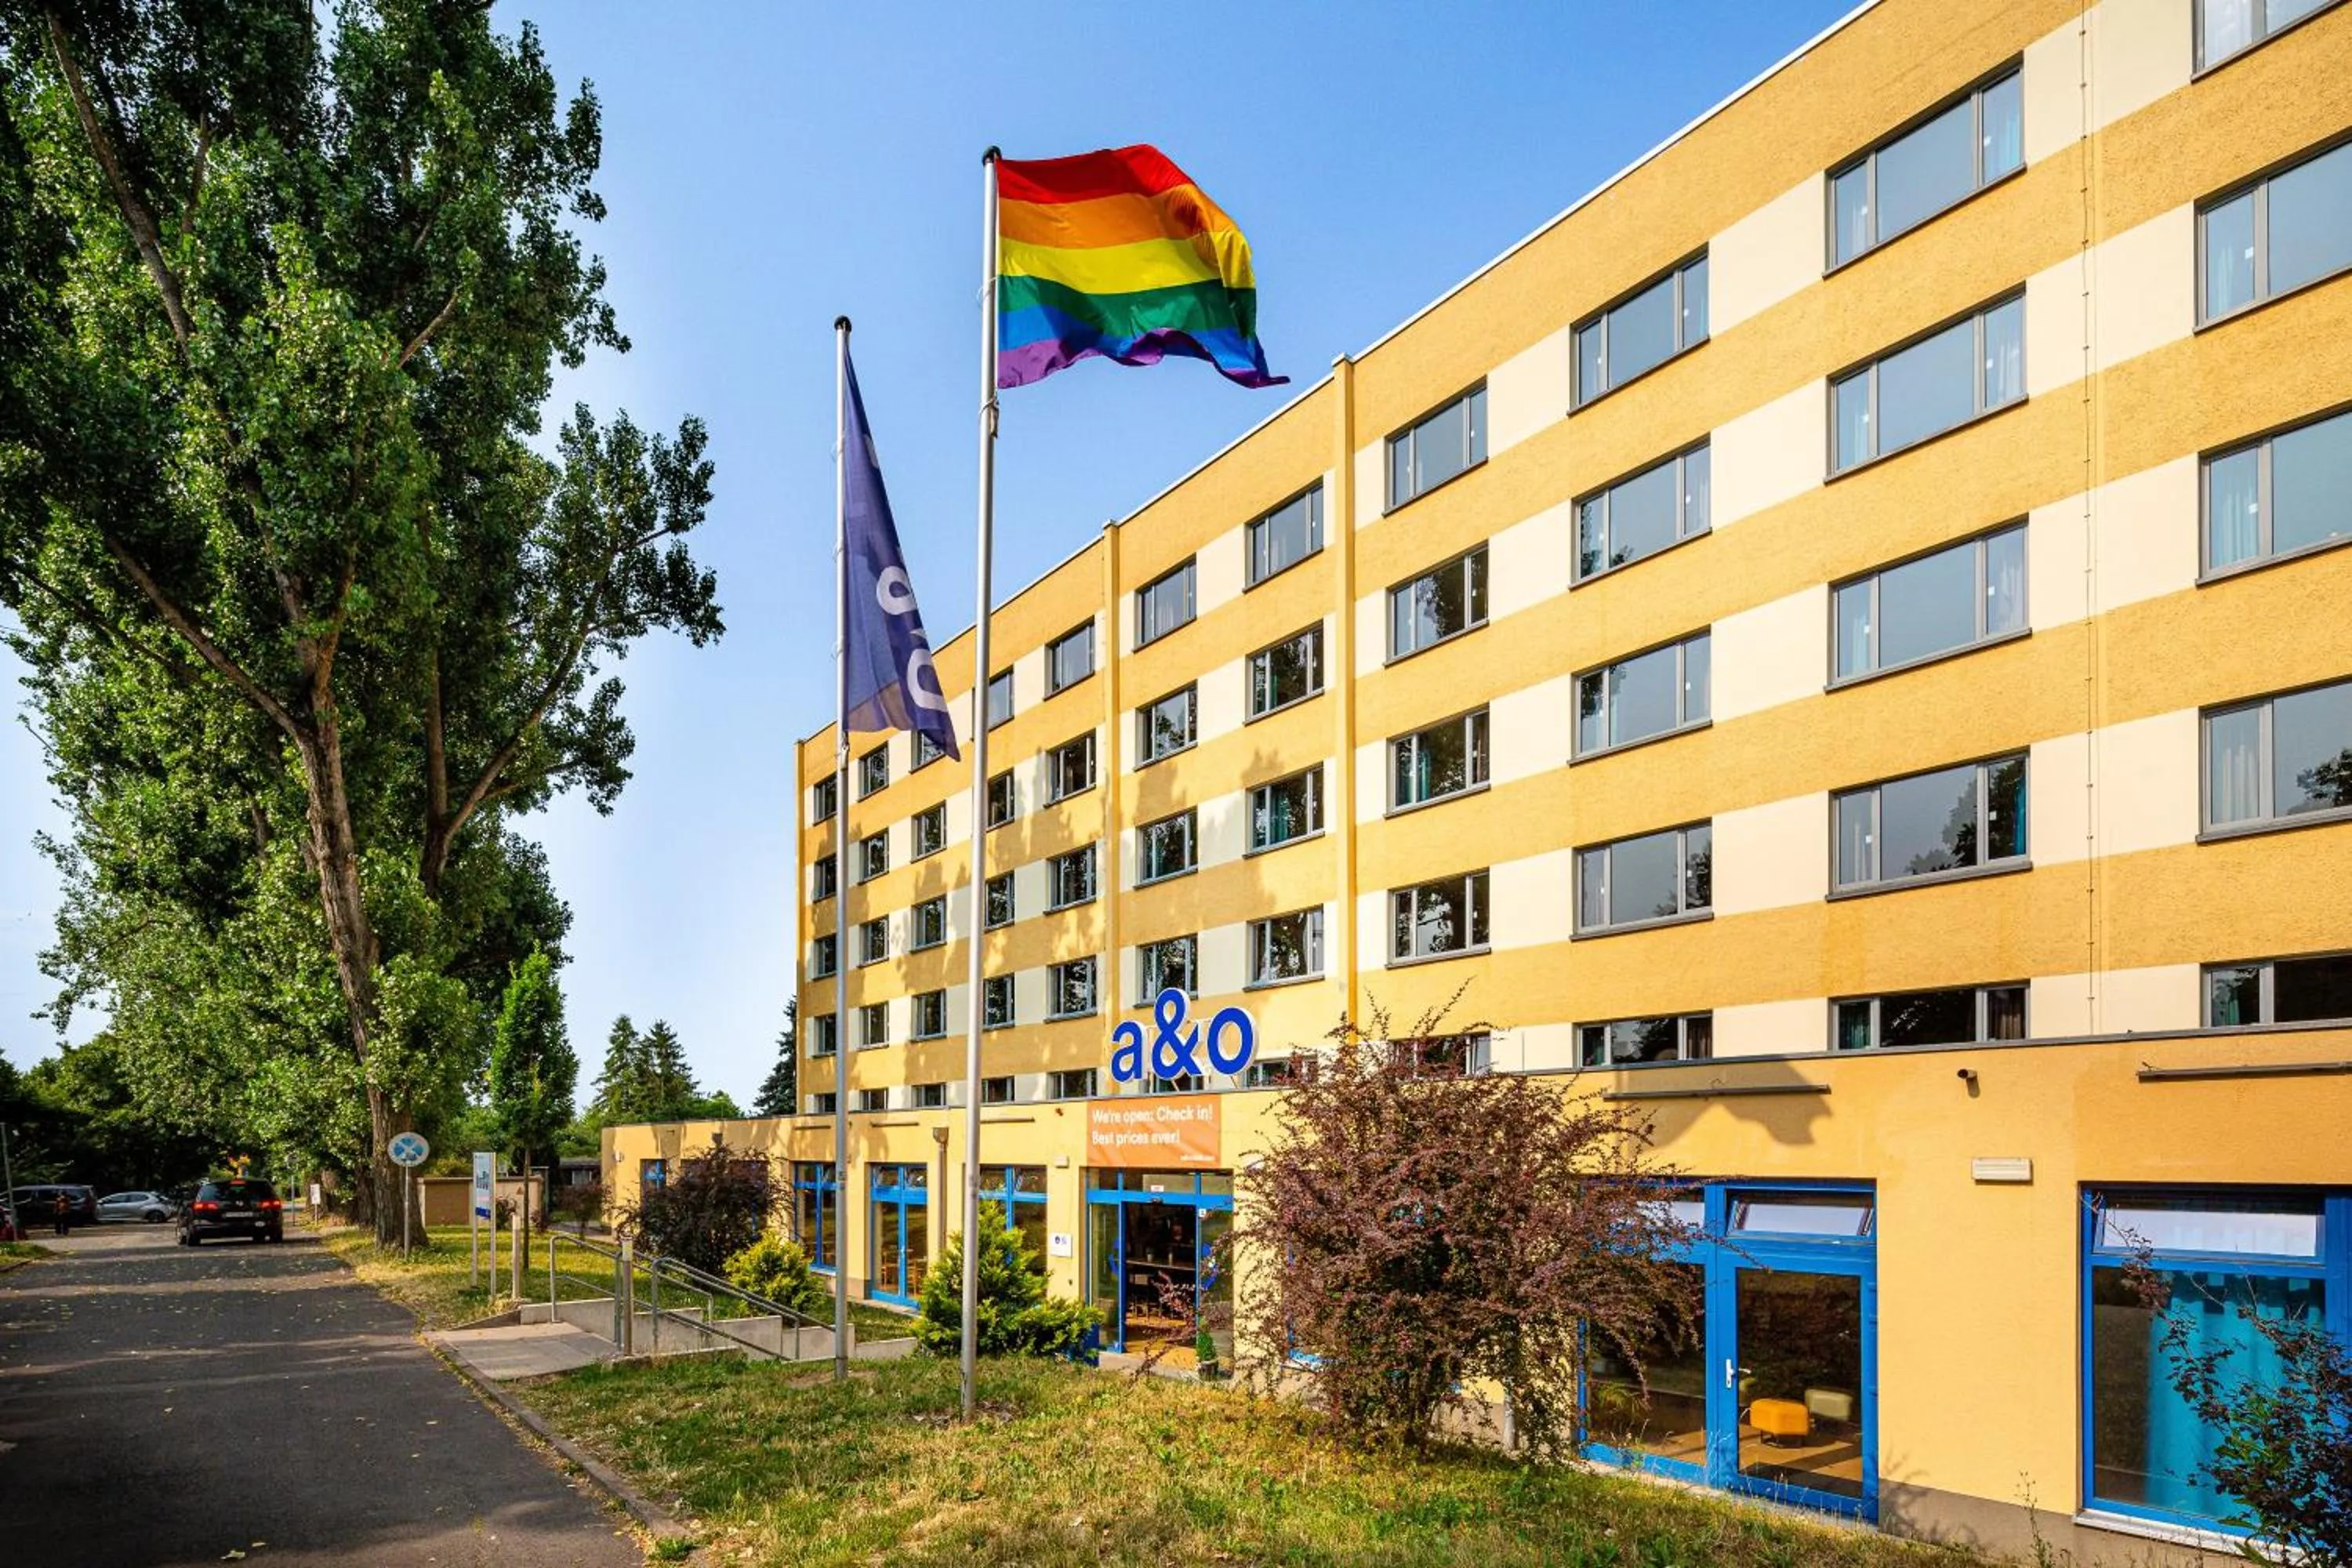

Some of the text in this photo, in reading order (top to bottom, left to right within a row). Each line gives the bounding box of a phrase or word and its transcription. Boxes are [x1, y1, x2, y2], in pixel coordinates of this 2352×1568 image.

[1110, 987, 1257, 1083] a&o
[1156, 1105, 1193, 1122] Check
[1197, 1104, 1214, 1121] in!
[1092, 1129, 1180, 1148] Best prices ever!
